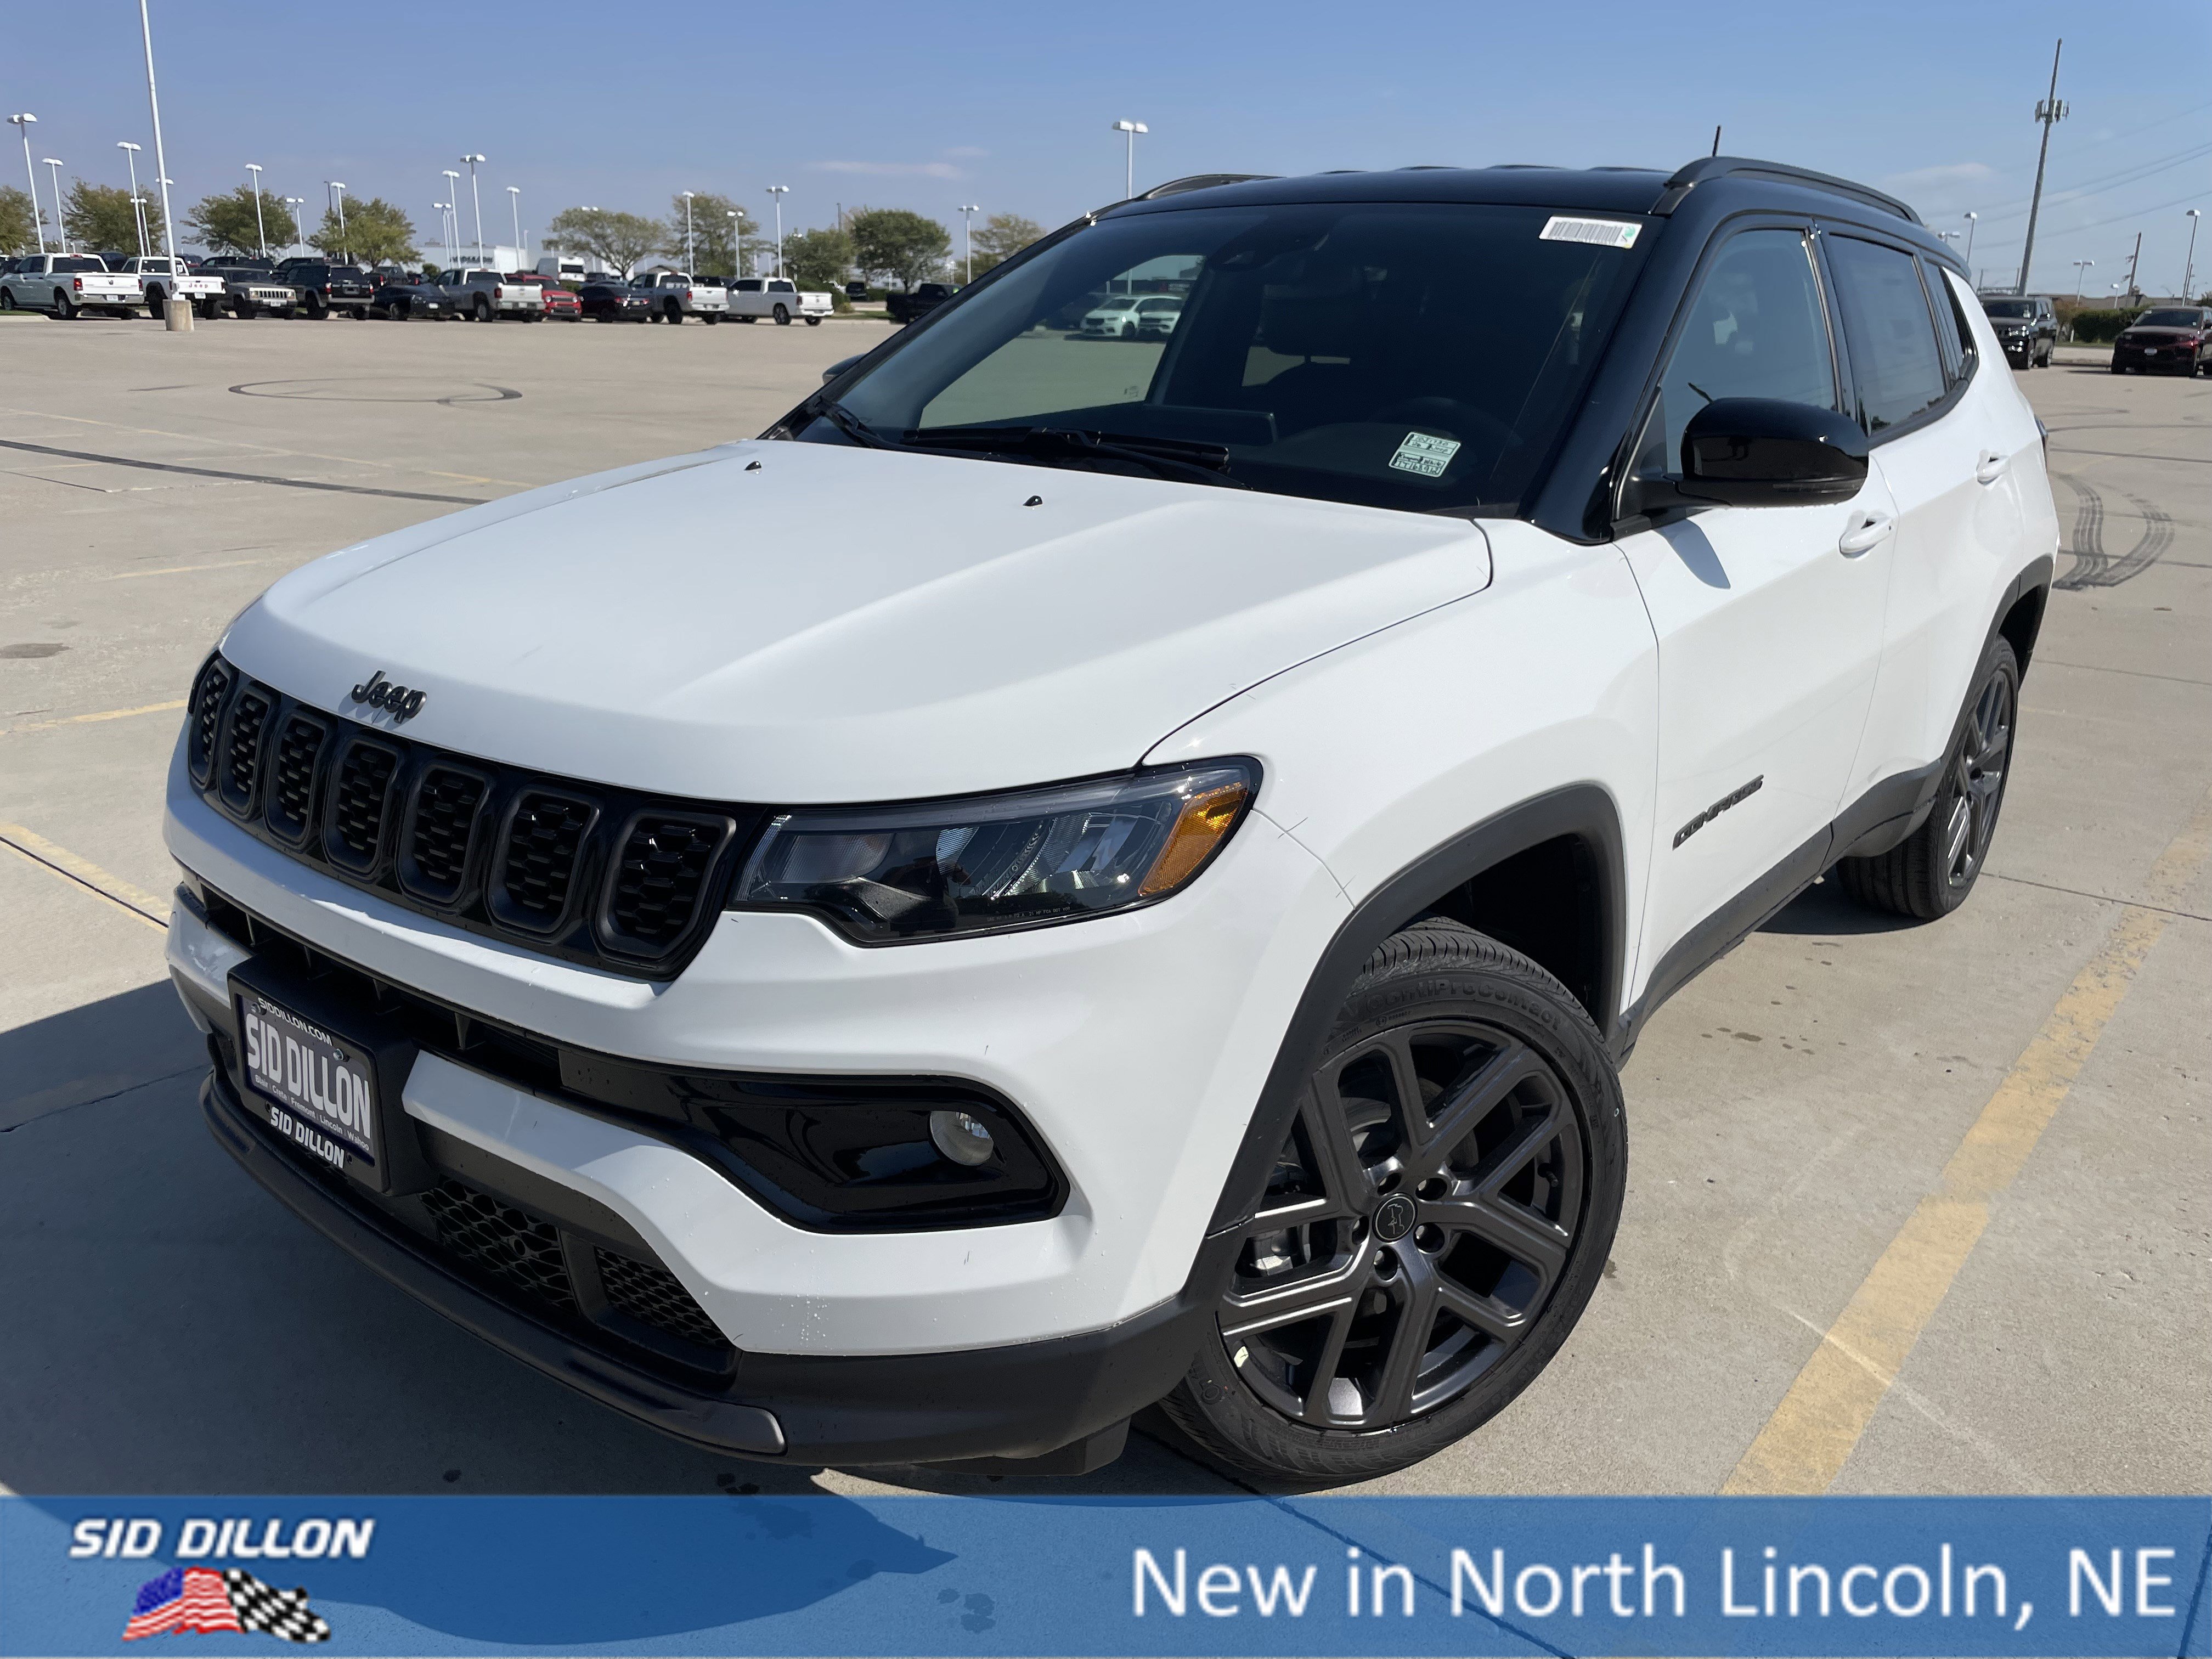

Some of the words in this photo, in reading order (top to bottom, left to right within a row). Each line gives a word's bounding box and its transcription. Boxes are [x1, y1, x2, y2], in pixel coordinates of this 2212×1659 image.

[351, 670, 427, 724] Jeep
[258, 997, 333, 1046] SIDDILLON.COM
[1366, 979, 1562, 1031] ContiProContact
[246, 1013, 282, 1084] SID
[286, 1036, 371, 1139] DILLON
[270, 1106, 294, 1135] SID
[295, 1121, 345, 1169] DILLON
[272, 1085, 287, 1101] Crete
[291, 1097, 316, 1119] Fremont
[320, 1114, 343, 1135] Lincoln
[347, 1130, 370, 1152] Wahoo
